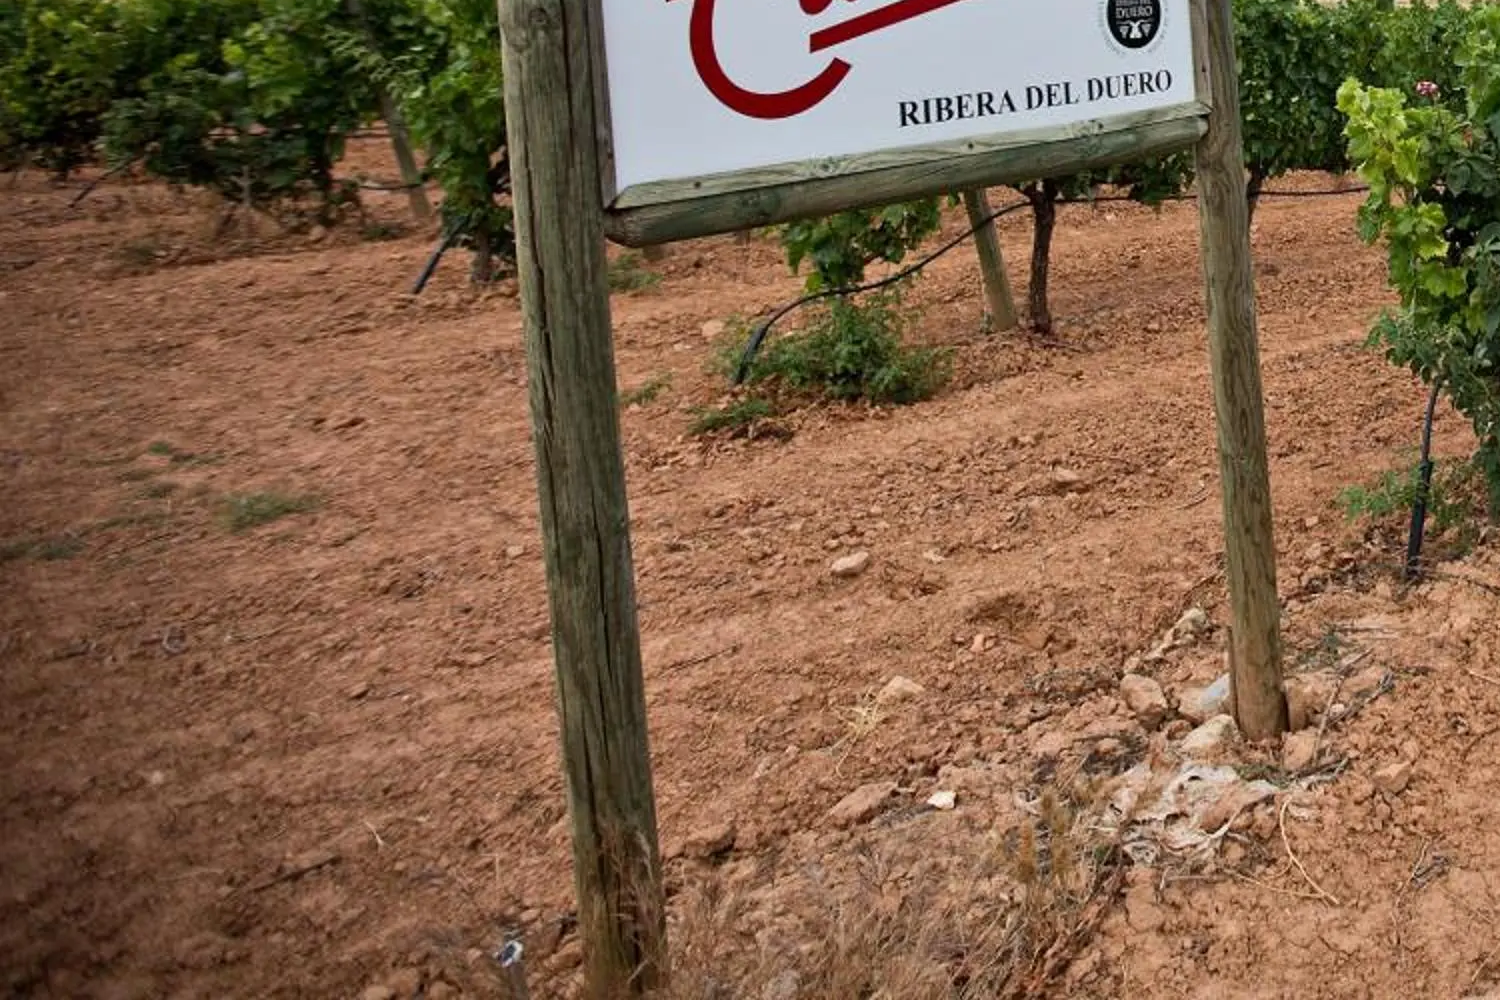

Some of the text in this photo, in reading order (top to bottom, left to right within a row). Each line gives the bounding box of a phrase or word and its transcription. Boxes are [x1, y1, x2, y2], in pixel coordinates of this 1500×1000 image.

[899, 69, 1172, 127] RIBERA DEL DUERO
